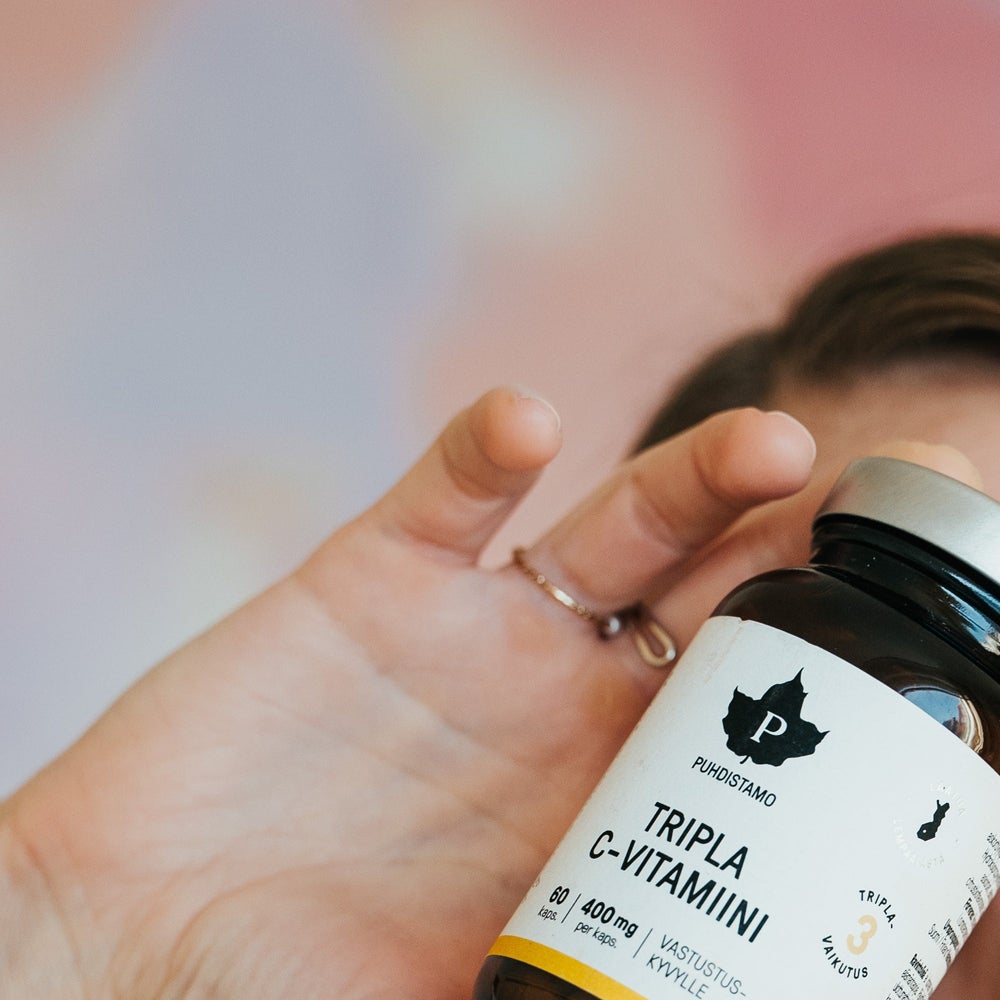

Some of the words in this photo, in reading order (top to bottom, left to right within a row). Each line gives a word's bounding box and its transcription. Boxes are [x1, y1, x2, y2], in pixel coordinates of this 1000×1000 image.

[750, 711, 787, 743] P
[692, 757, 777, 807] PUHDISTAMO
[644, 802, 749, 879] TRIPLA
[549, 886, 570, 905] 60
[589, 830, 769, 943] C-VITAMIINI
[538, 905, 557, 921] kaps.
[574, 921, 593, 936] per
[593, 927, 617, 949] kaps.
[859, 890, 896, 928] TRIPLA-
[822, 935, 868, 979] VAIKUTUS
[847, 915, 878, 955] 3
[647, 953, 709, 1000] KYVYLLE
[660, 934, 747, 998] VASTUSTUS-
